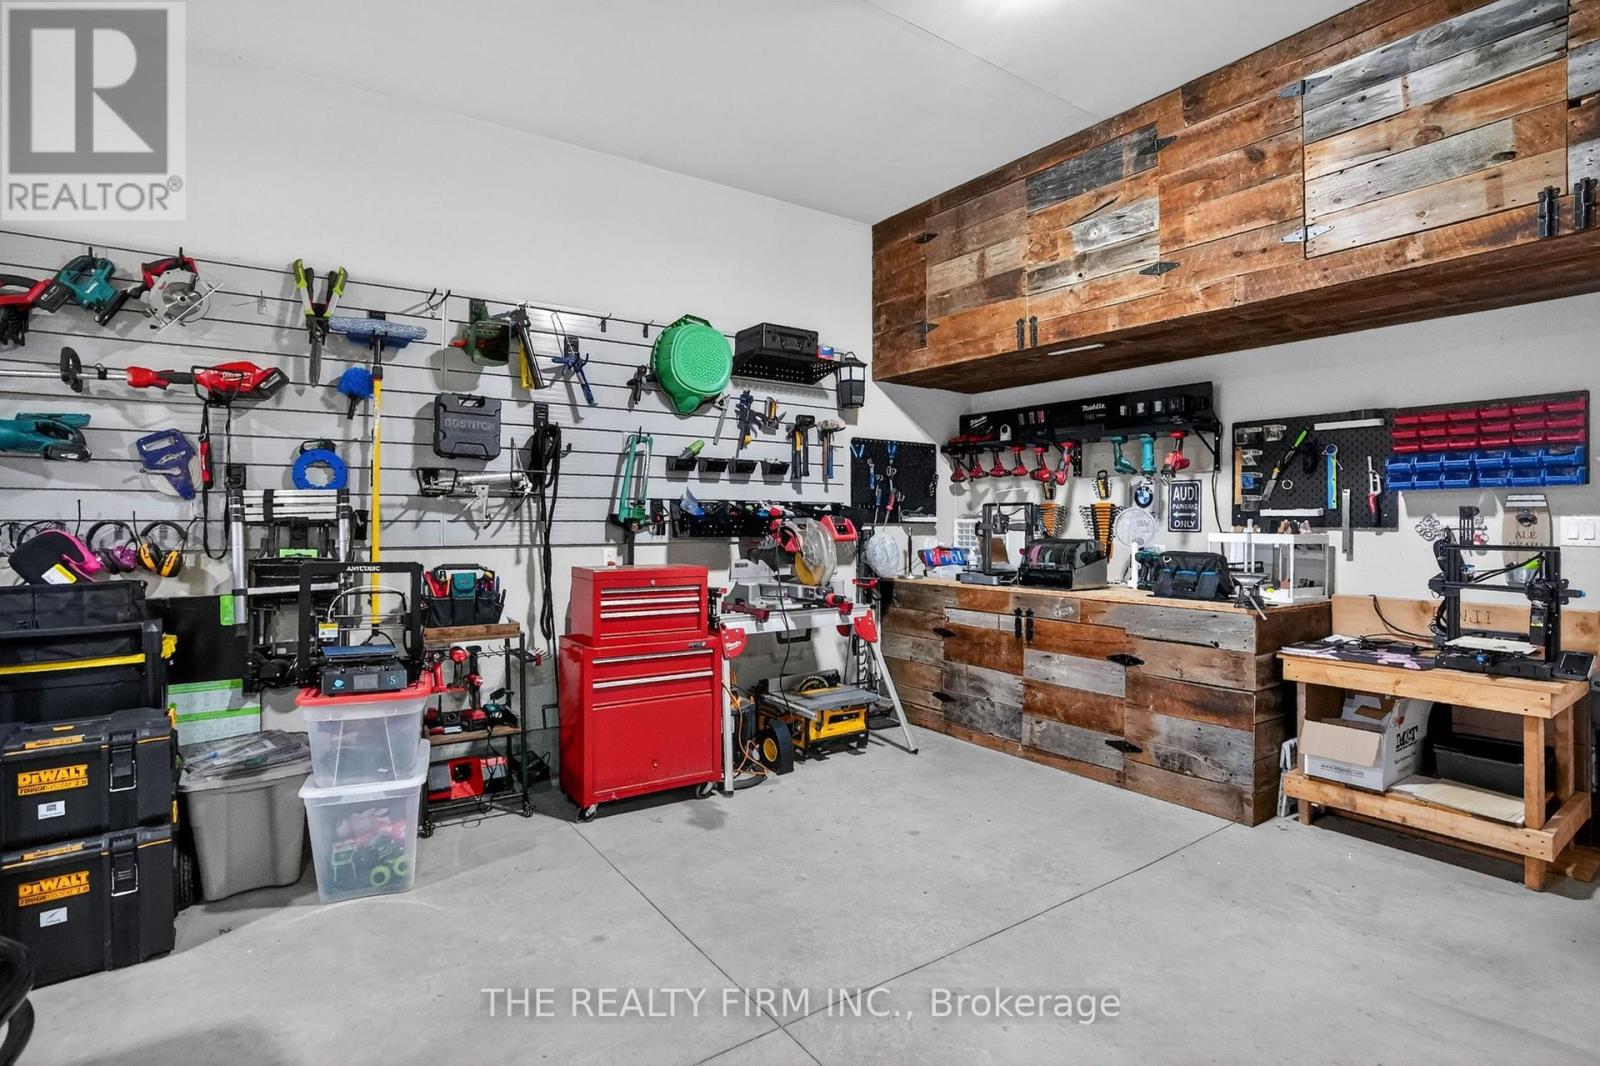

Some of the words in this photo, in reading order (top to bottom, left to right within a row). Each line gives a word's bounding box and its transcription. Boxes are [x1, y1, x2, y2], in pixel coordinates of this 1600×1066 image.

[444, 417, 497, 431] BOSTITCH
[1173, 486, 1198, 501] AUDI
[1173, 519, 1196, 528] ONLY
[18, 764, 88, 788] DEWALT
[19, 871, 89, 898] DEWALT
